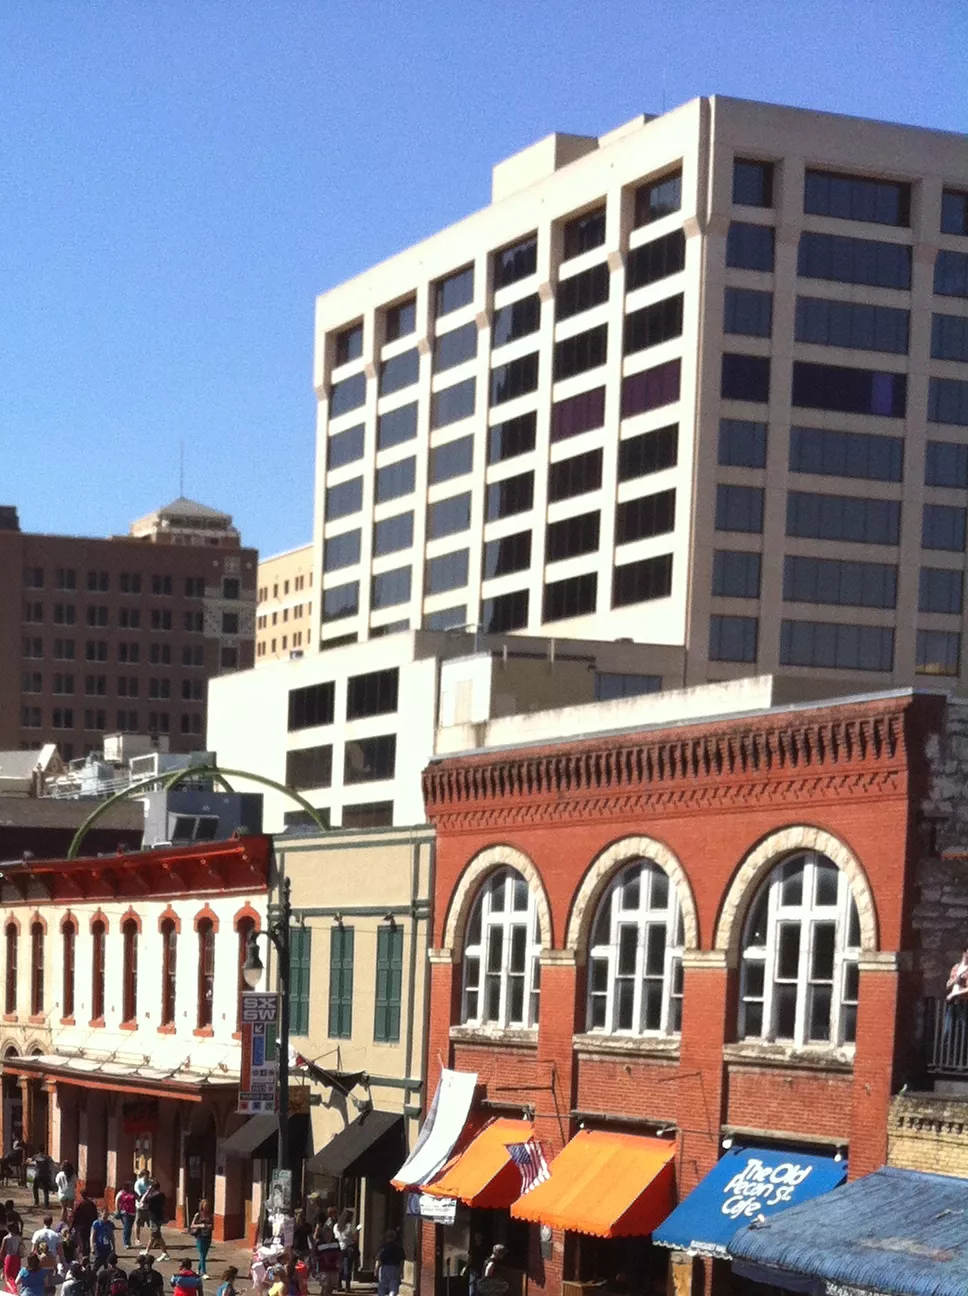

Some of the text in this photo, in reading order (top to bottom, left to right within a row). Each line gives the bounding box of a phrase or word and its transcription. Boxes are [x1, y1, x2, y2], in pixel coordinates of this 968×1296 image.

[243, 997, 276, 1009] SX
[243, 1009, 276, 1021] SW
[742, 1158, 813, 1185] The Old
[723, 1173, 774, 1198] Pecan
[722, 1195, 762, 1219] Cafe
